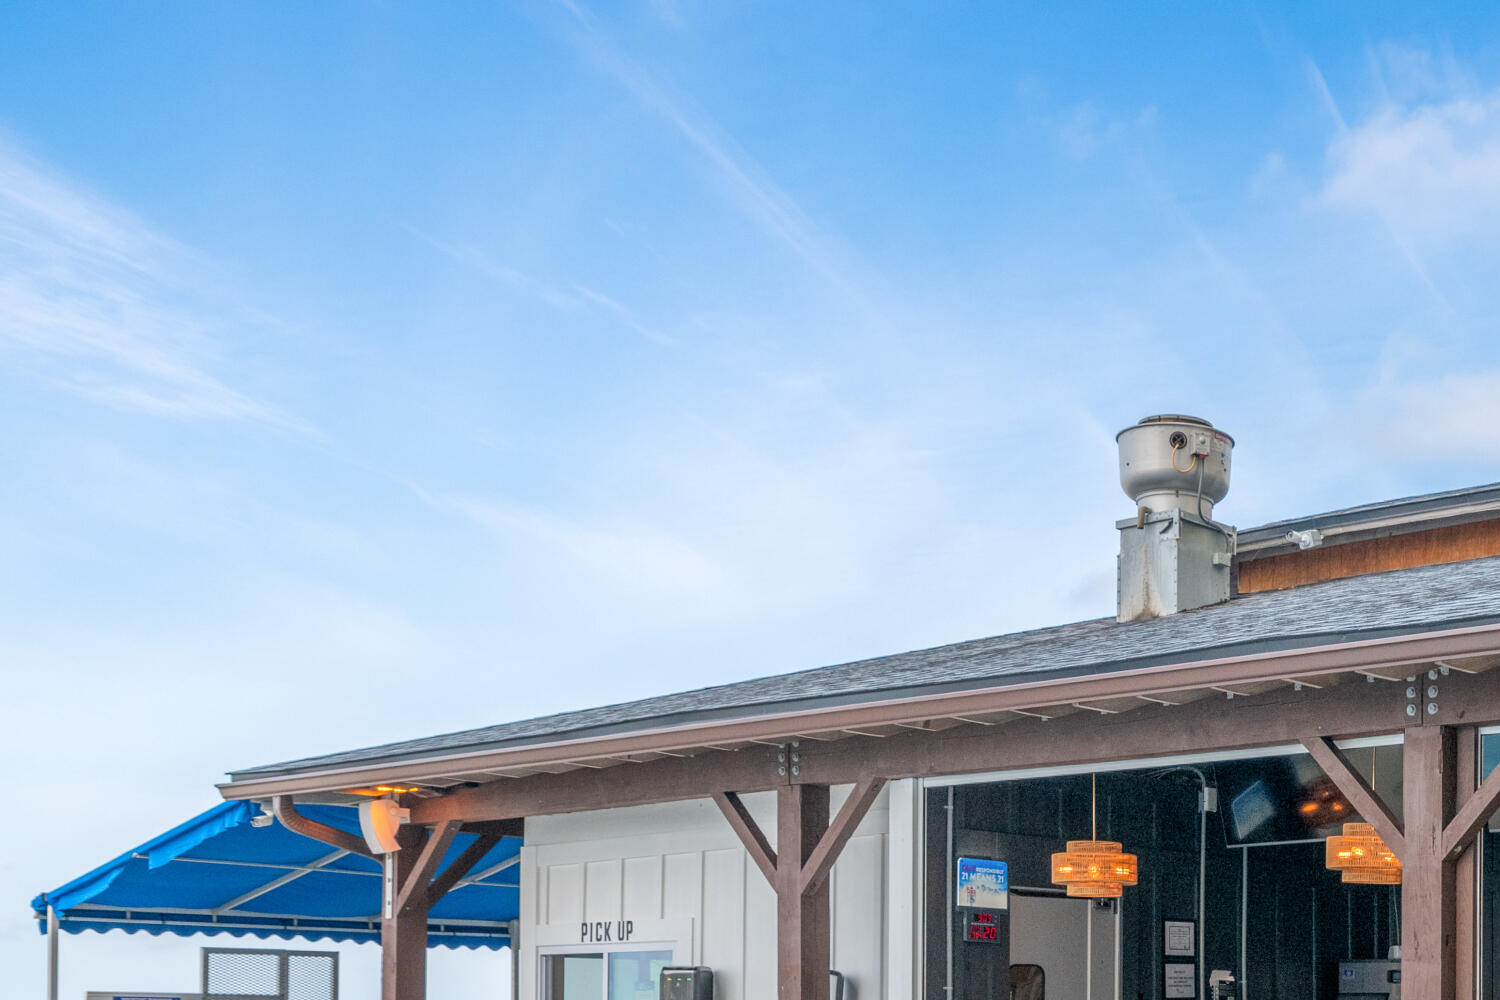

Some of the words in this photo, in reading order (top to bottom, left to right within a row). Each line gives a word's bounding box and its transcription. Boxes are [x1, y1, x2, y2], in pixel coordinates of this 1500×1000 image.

[961, 872, 968, 880] 21
[969, 872, 996, 881] MEANS
[997, 875, 1004, 883] 21
[581, 921, 612, 943] PICK
[618, 920, 633, 941] UP
